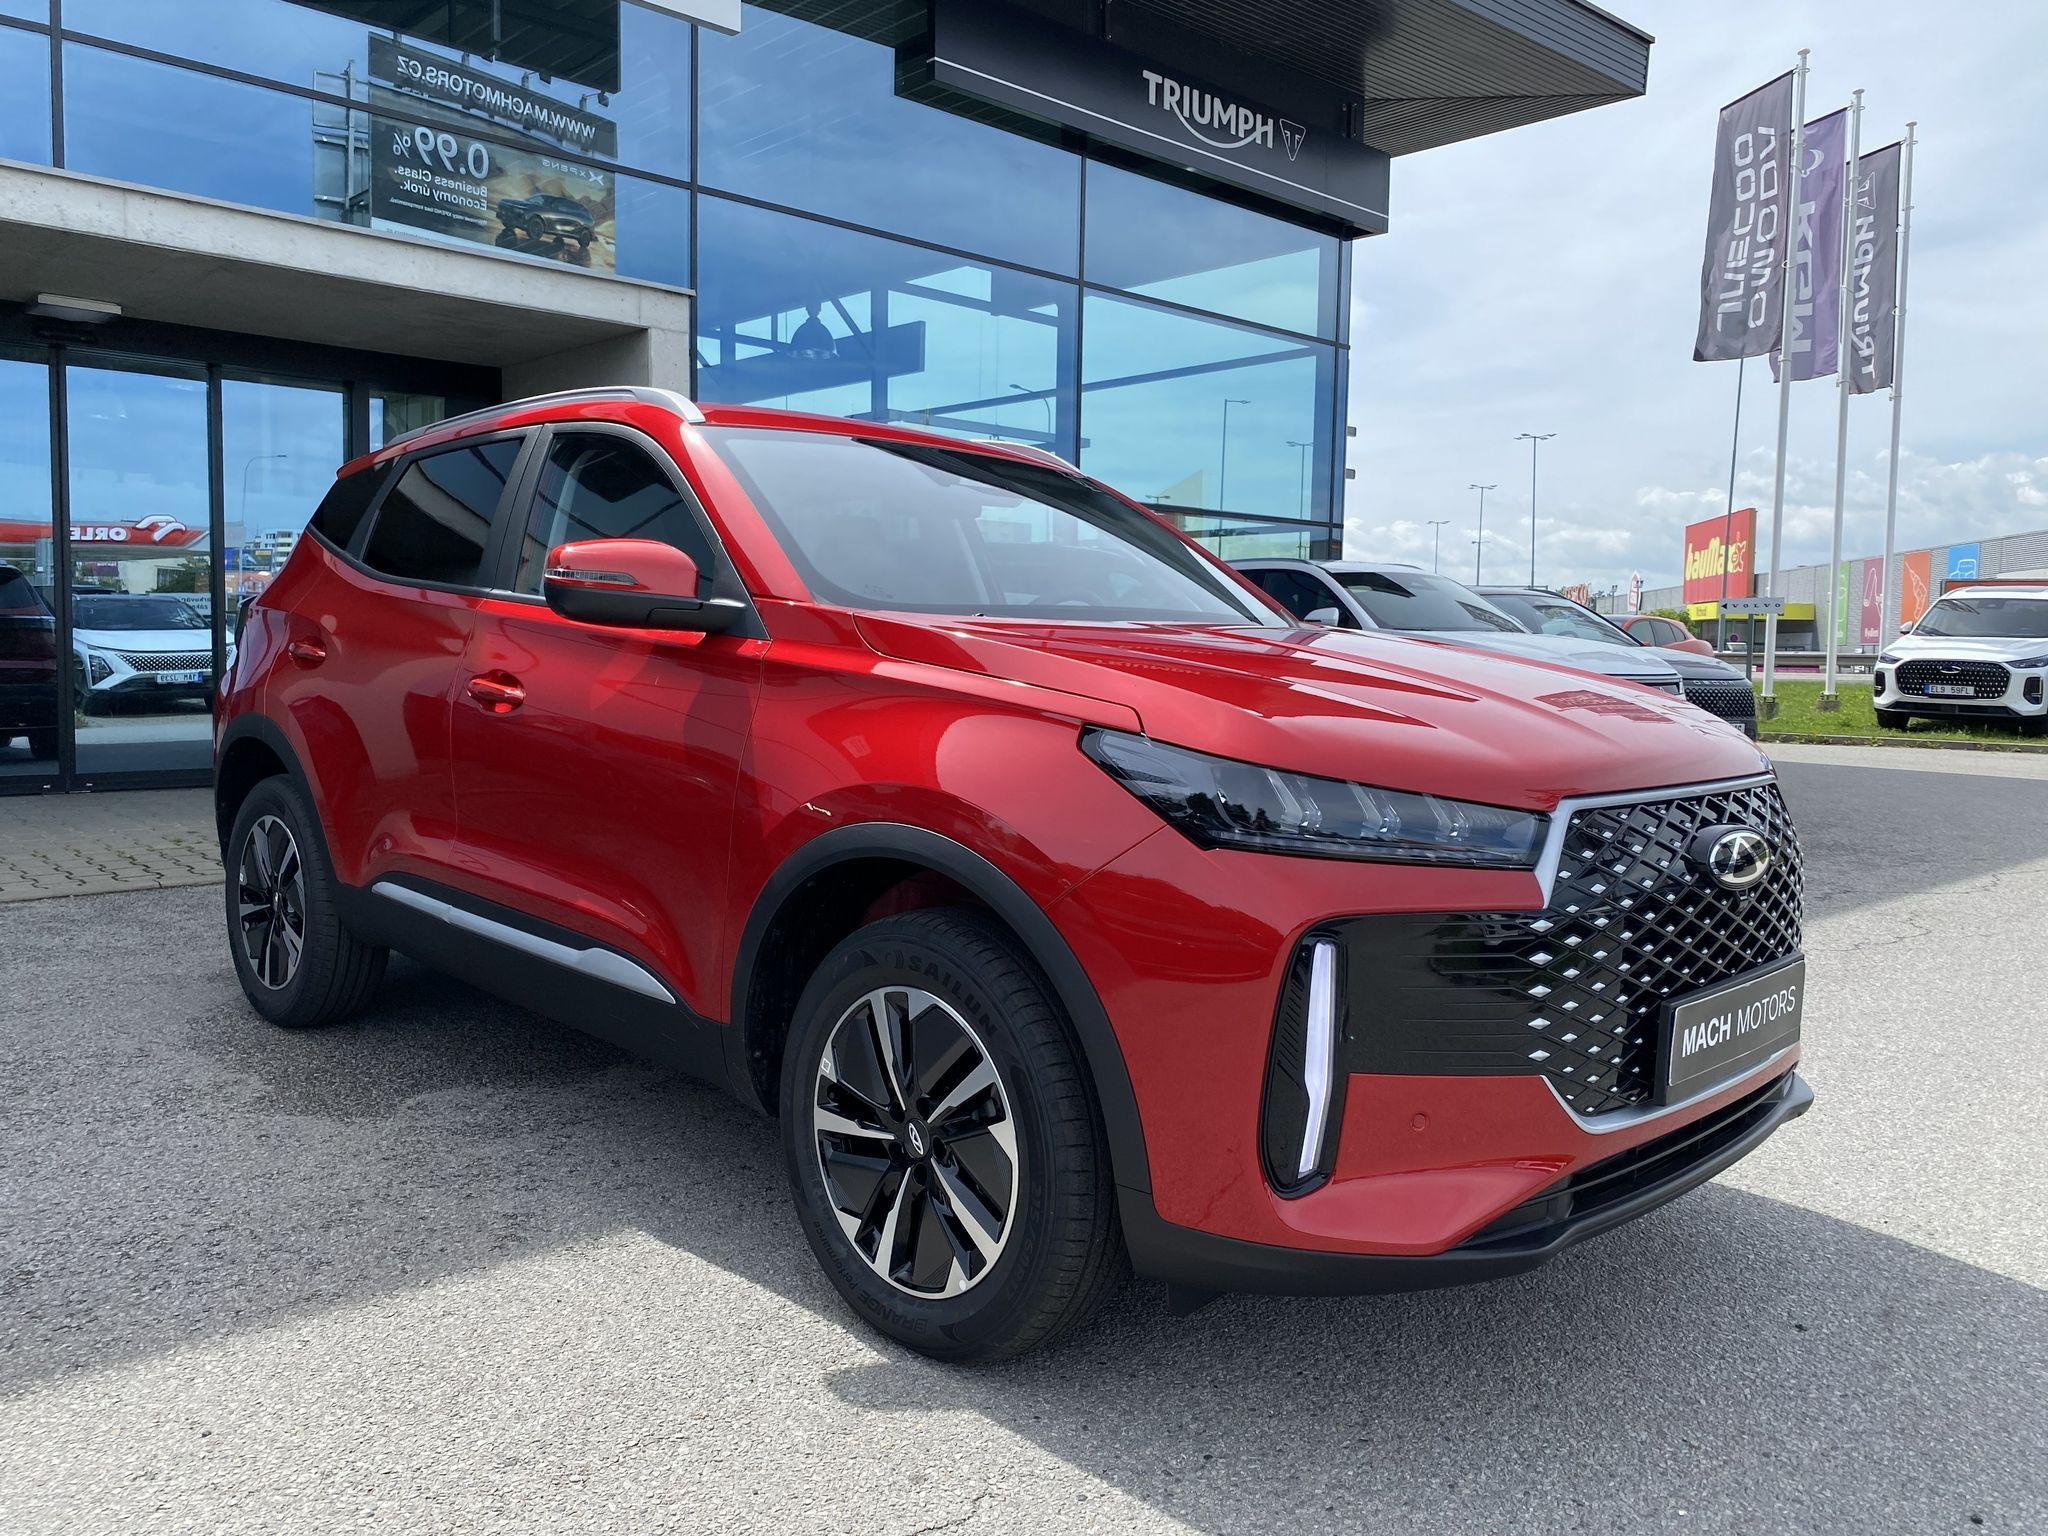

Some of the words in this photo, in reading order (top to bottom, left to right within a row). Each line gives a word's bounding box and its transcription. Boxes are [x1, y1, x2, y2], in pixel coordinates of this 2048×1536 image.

[1142, 69, 1274, 149] TRIUMPH
[908, 954, 998, 1037] SAILUN
[1682, 1012, 1732, 1058] MACH
[1737, 985, 1797, 1036] MOTORS
